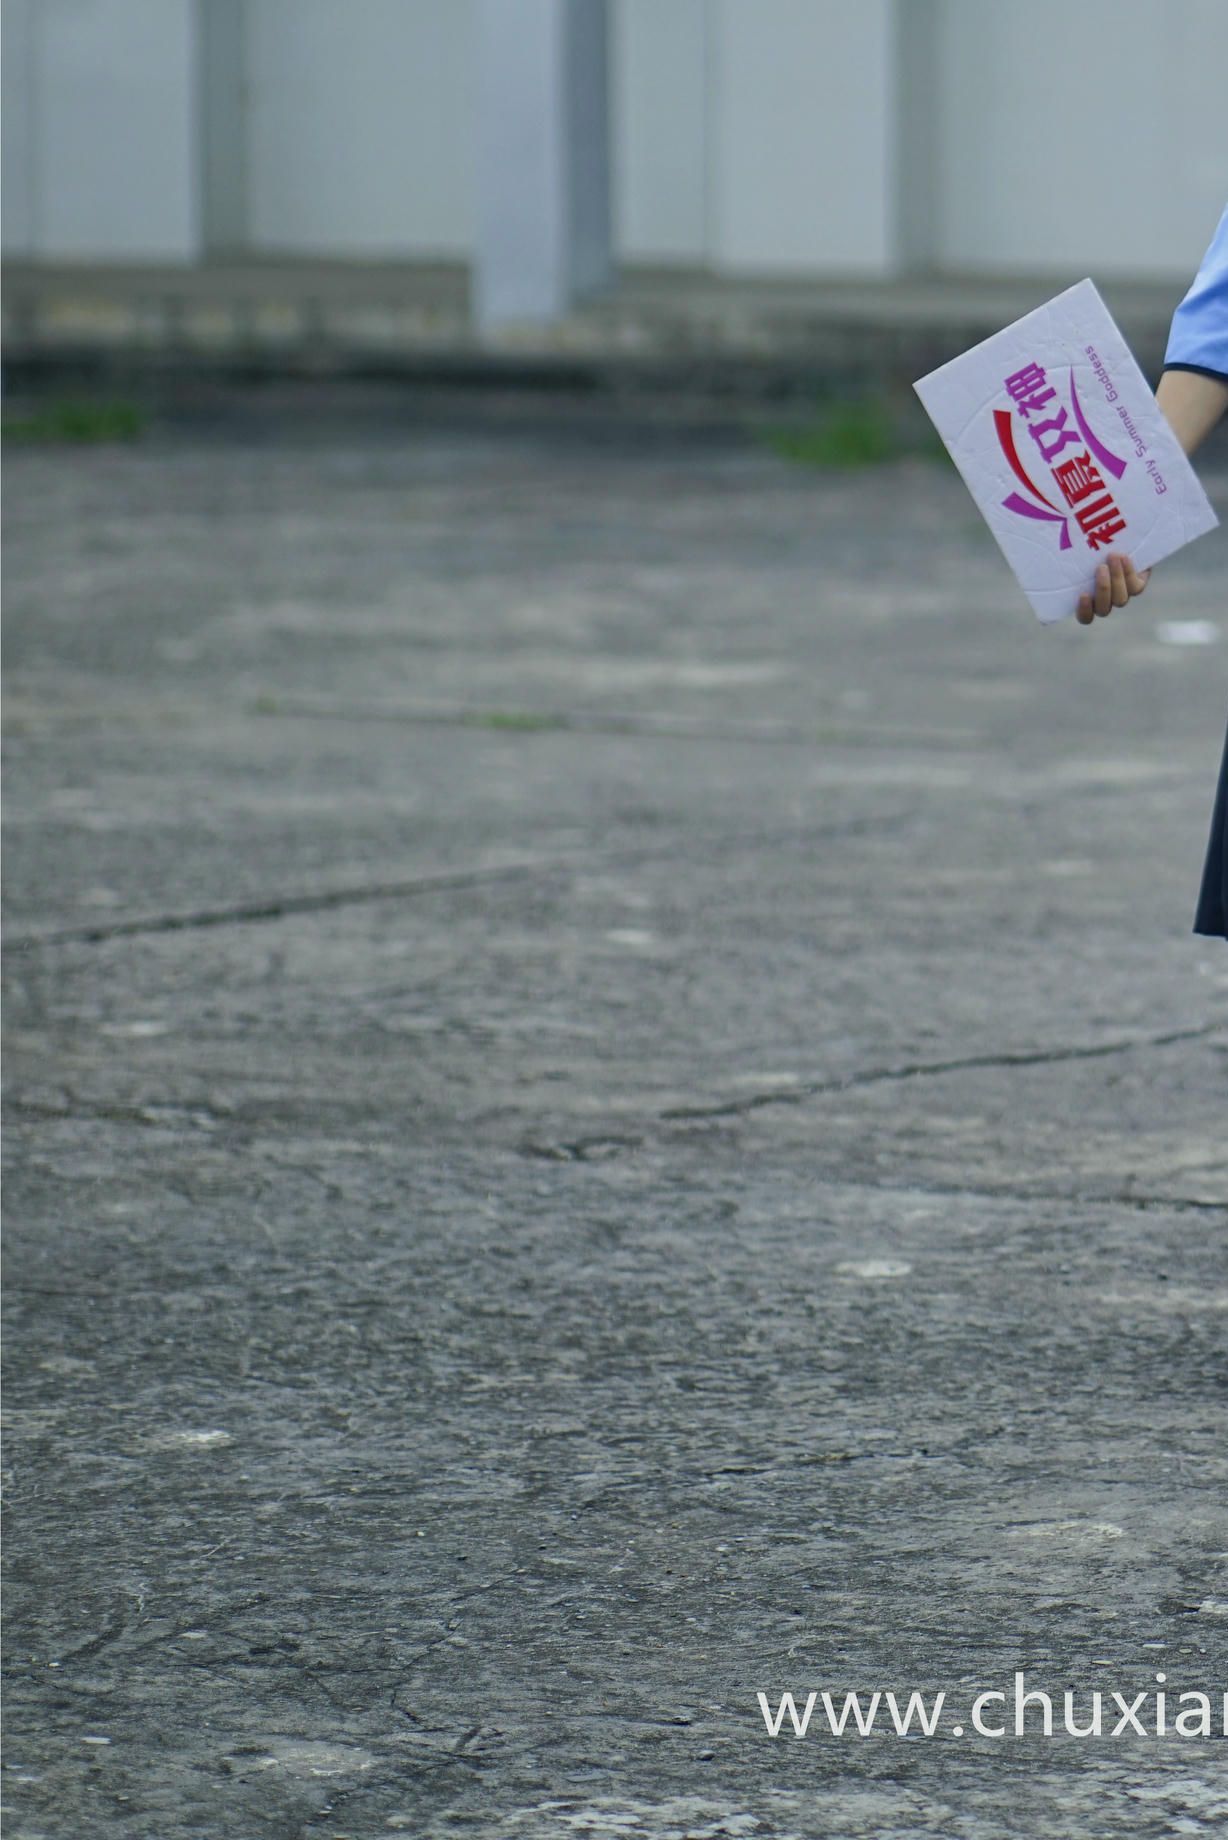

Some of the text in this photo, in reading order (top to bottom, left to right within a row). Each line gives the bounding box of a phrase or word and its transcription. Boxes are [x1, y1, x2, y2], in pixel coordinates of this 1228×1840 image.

[1004, 362, 1127, 551] 初夏女神
[1084, 345, 1168, 496] Early Summer Goddess
